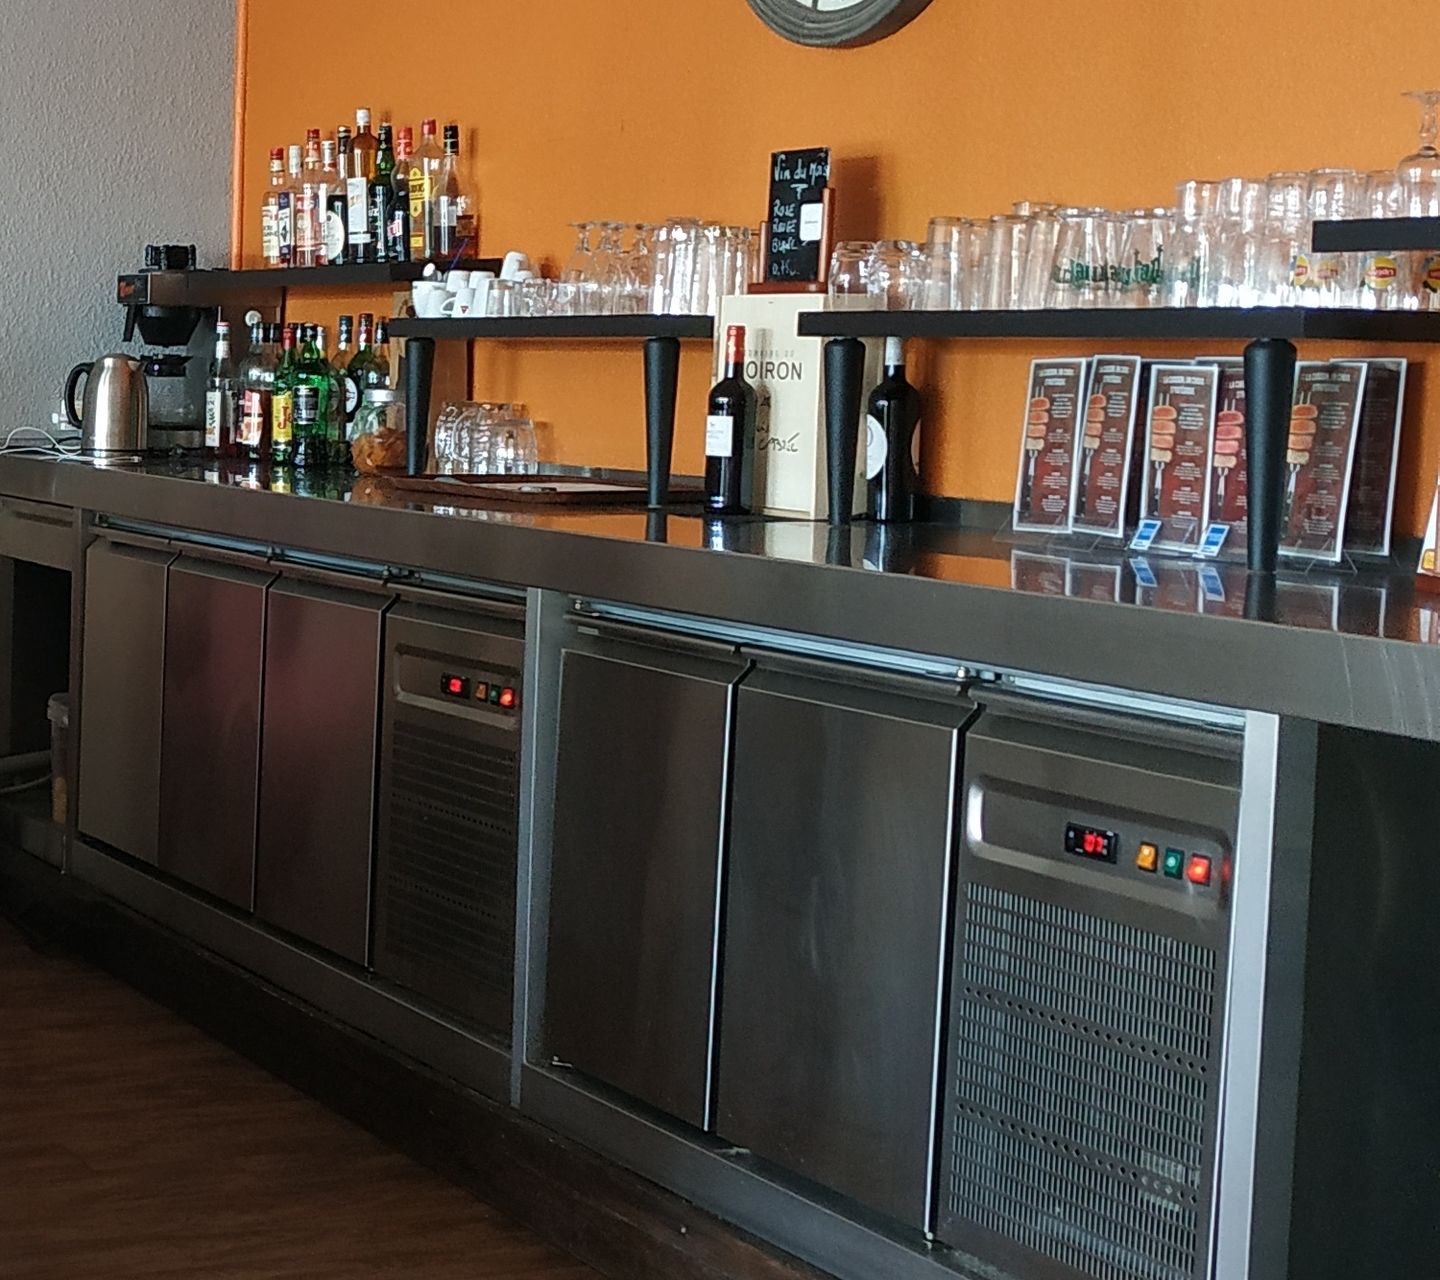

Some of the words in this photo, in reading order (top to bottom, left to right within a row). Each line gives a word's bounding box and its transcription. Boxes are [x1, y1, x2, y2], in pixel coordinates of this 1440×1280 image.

[774, 154, 791, 182] Vin
[793, 158, 807, 180] du
[745, 361, 802, 380] OIRON
